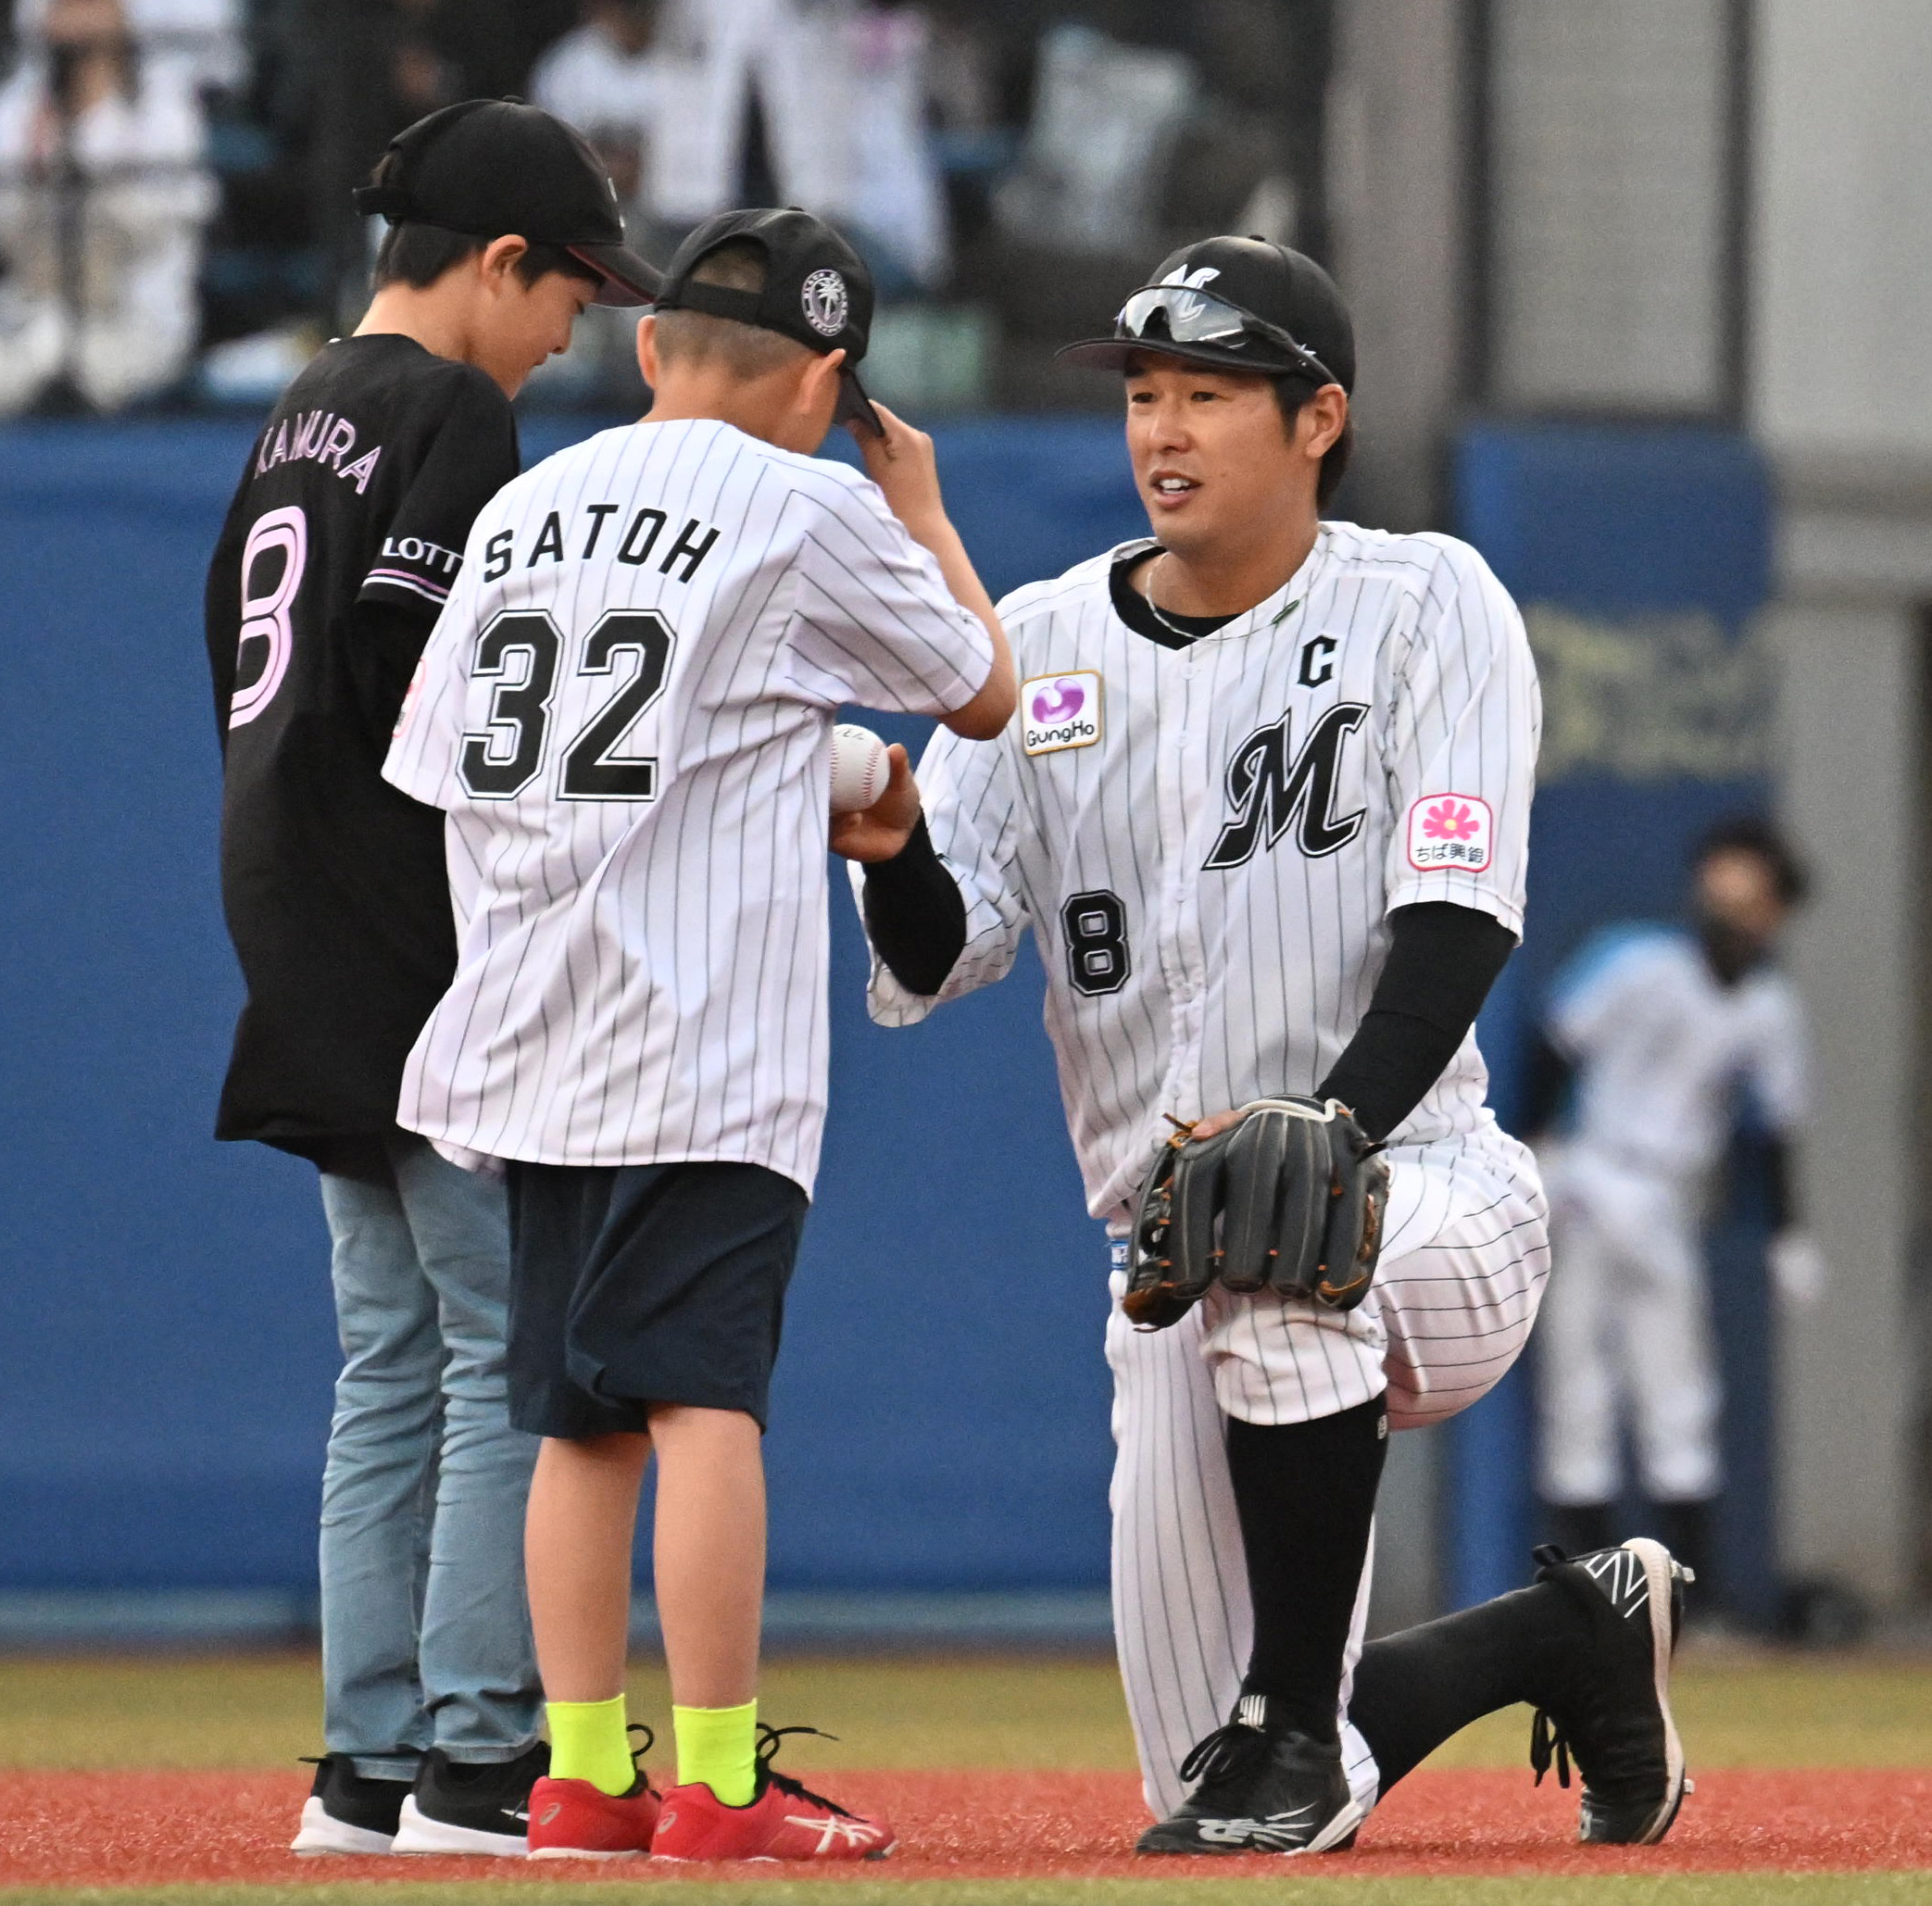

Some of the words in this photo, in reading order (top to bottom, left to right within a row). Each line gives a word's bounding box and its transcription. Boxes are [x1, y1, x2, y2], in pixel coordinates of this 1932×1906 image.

[483, 504, 721, 584] SATOH
[1298, 634, 1338, 689] C
[455, 608, 678, 802] 32
[1026, 720, 1095, 747] GungHo
[1200, 701, 1371, 871] M
[1414, 843, 1485, 863] ちば興銀
[1060, 888, 1132, 997] 8
